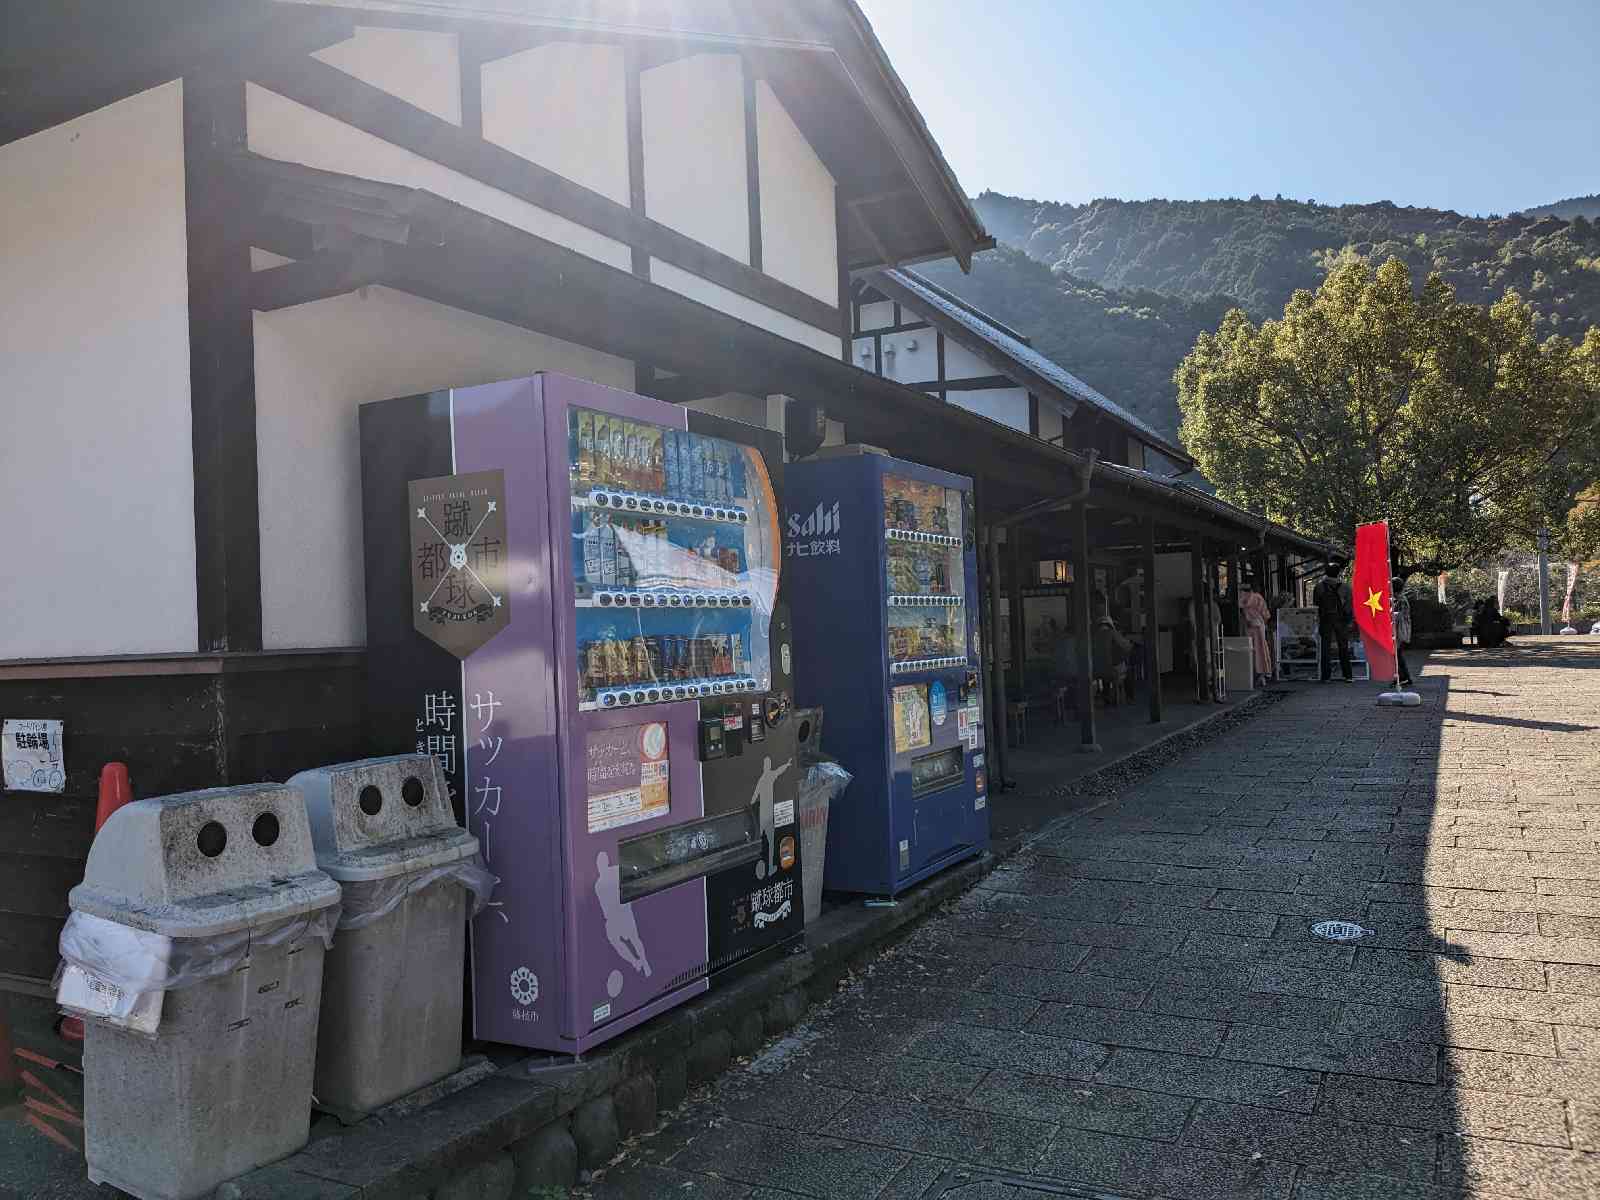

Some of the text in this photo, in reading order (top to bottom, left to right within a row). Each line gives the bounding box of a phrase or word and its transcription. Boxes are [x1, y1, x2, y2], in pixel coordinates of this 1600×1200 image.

[784, 501, 841, 538] sahi
[785, 539, 841, 557] サヒ飲料
[425, 690, 457, 797] 時間
